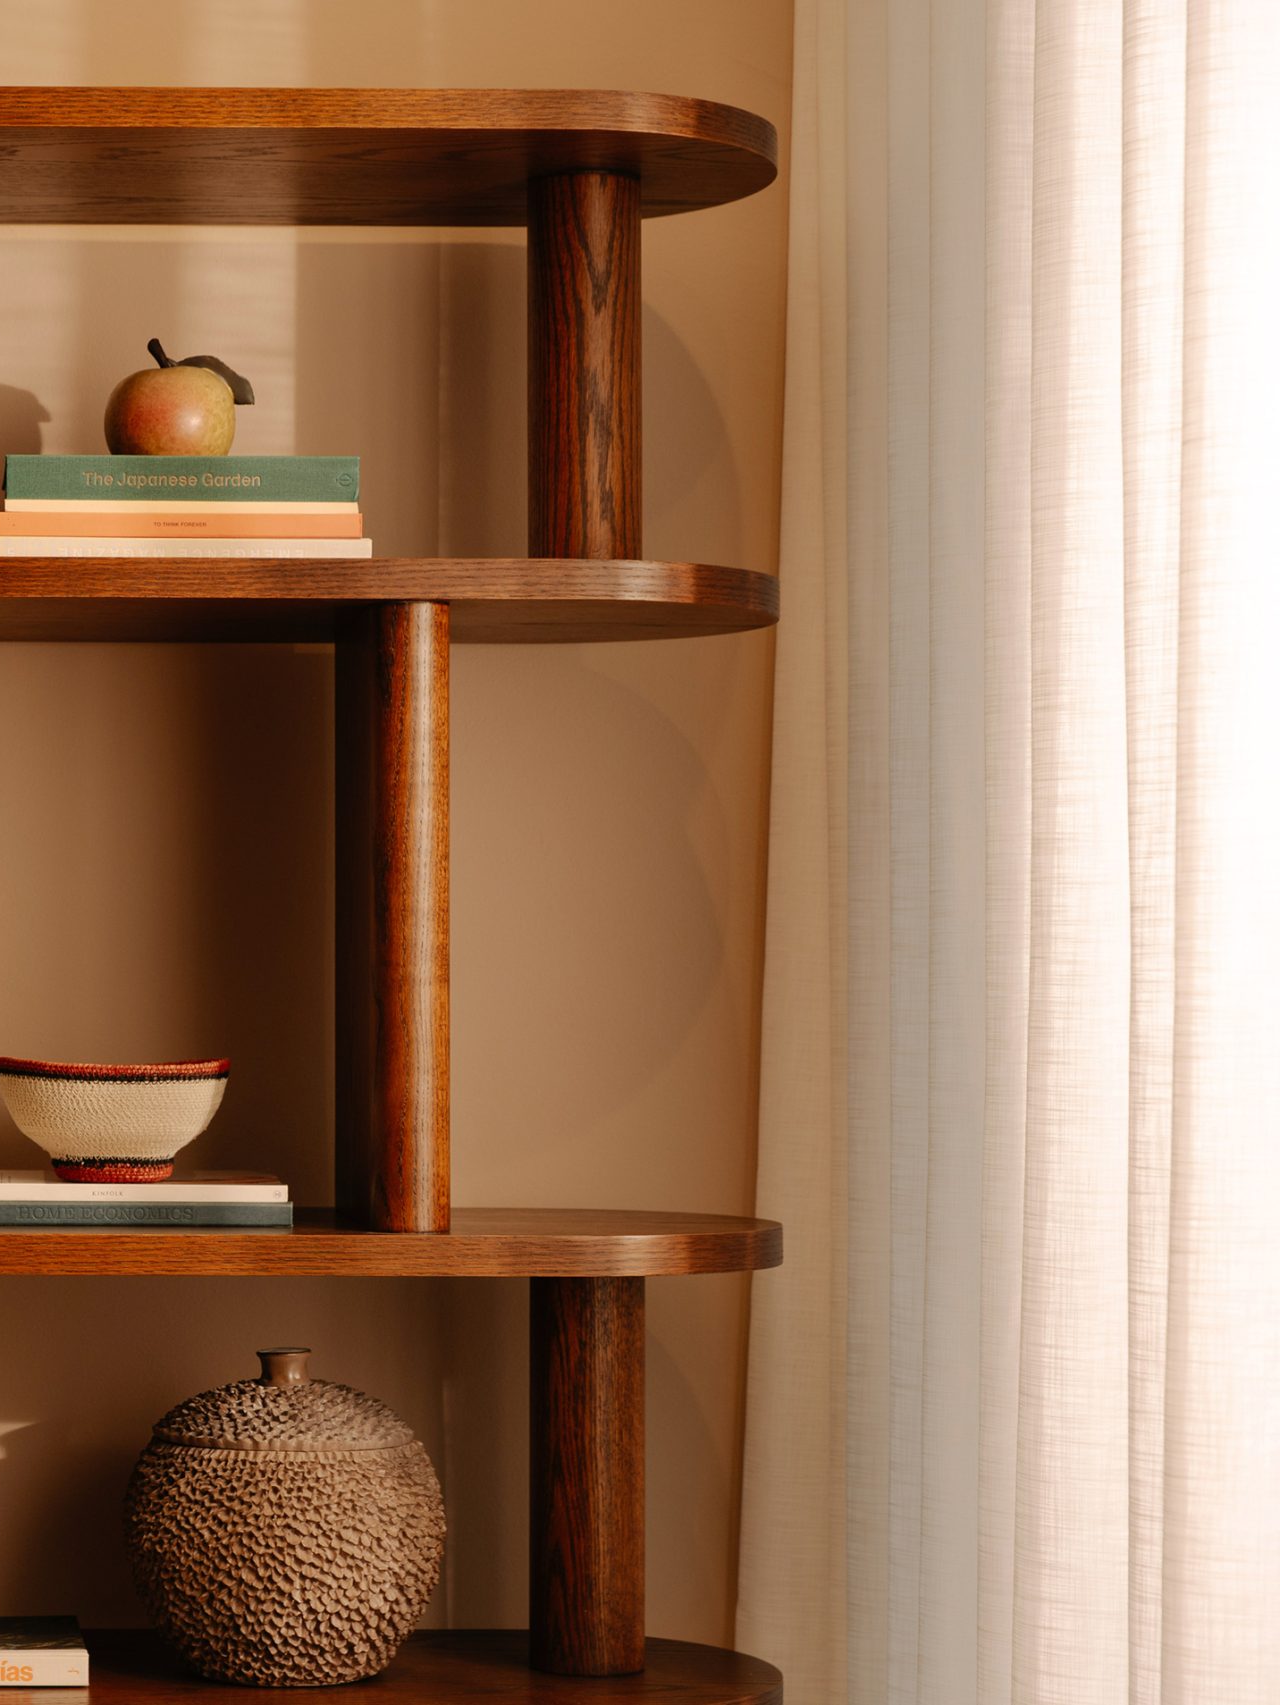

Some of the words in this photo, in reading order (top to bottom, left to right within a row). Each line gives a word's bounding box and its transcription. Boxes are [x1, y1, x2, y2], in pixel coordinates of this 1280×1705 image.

[82, 471, 114, 487] The
[117, 471, 198, 489] Japanese
[202, 472, 262, 487] Garden
[16, 1206, 73, 1221] HOME
[81, 1206, 195, 1221] ECONOMICS
